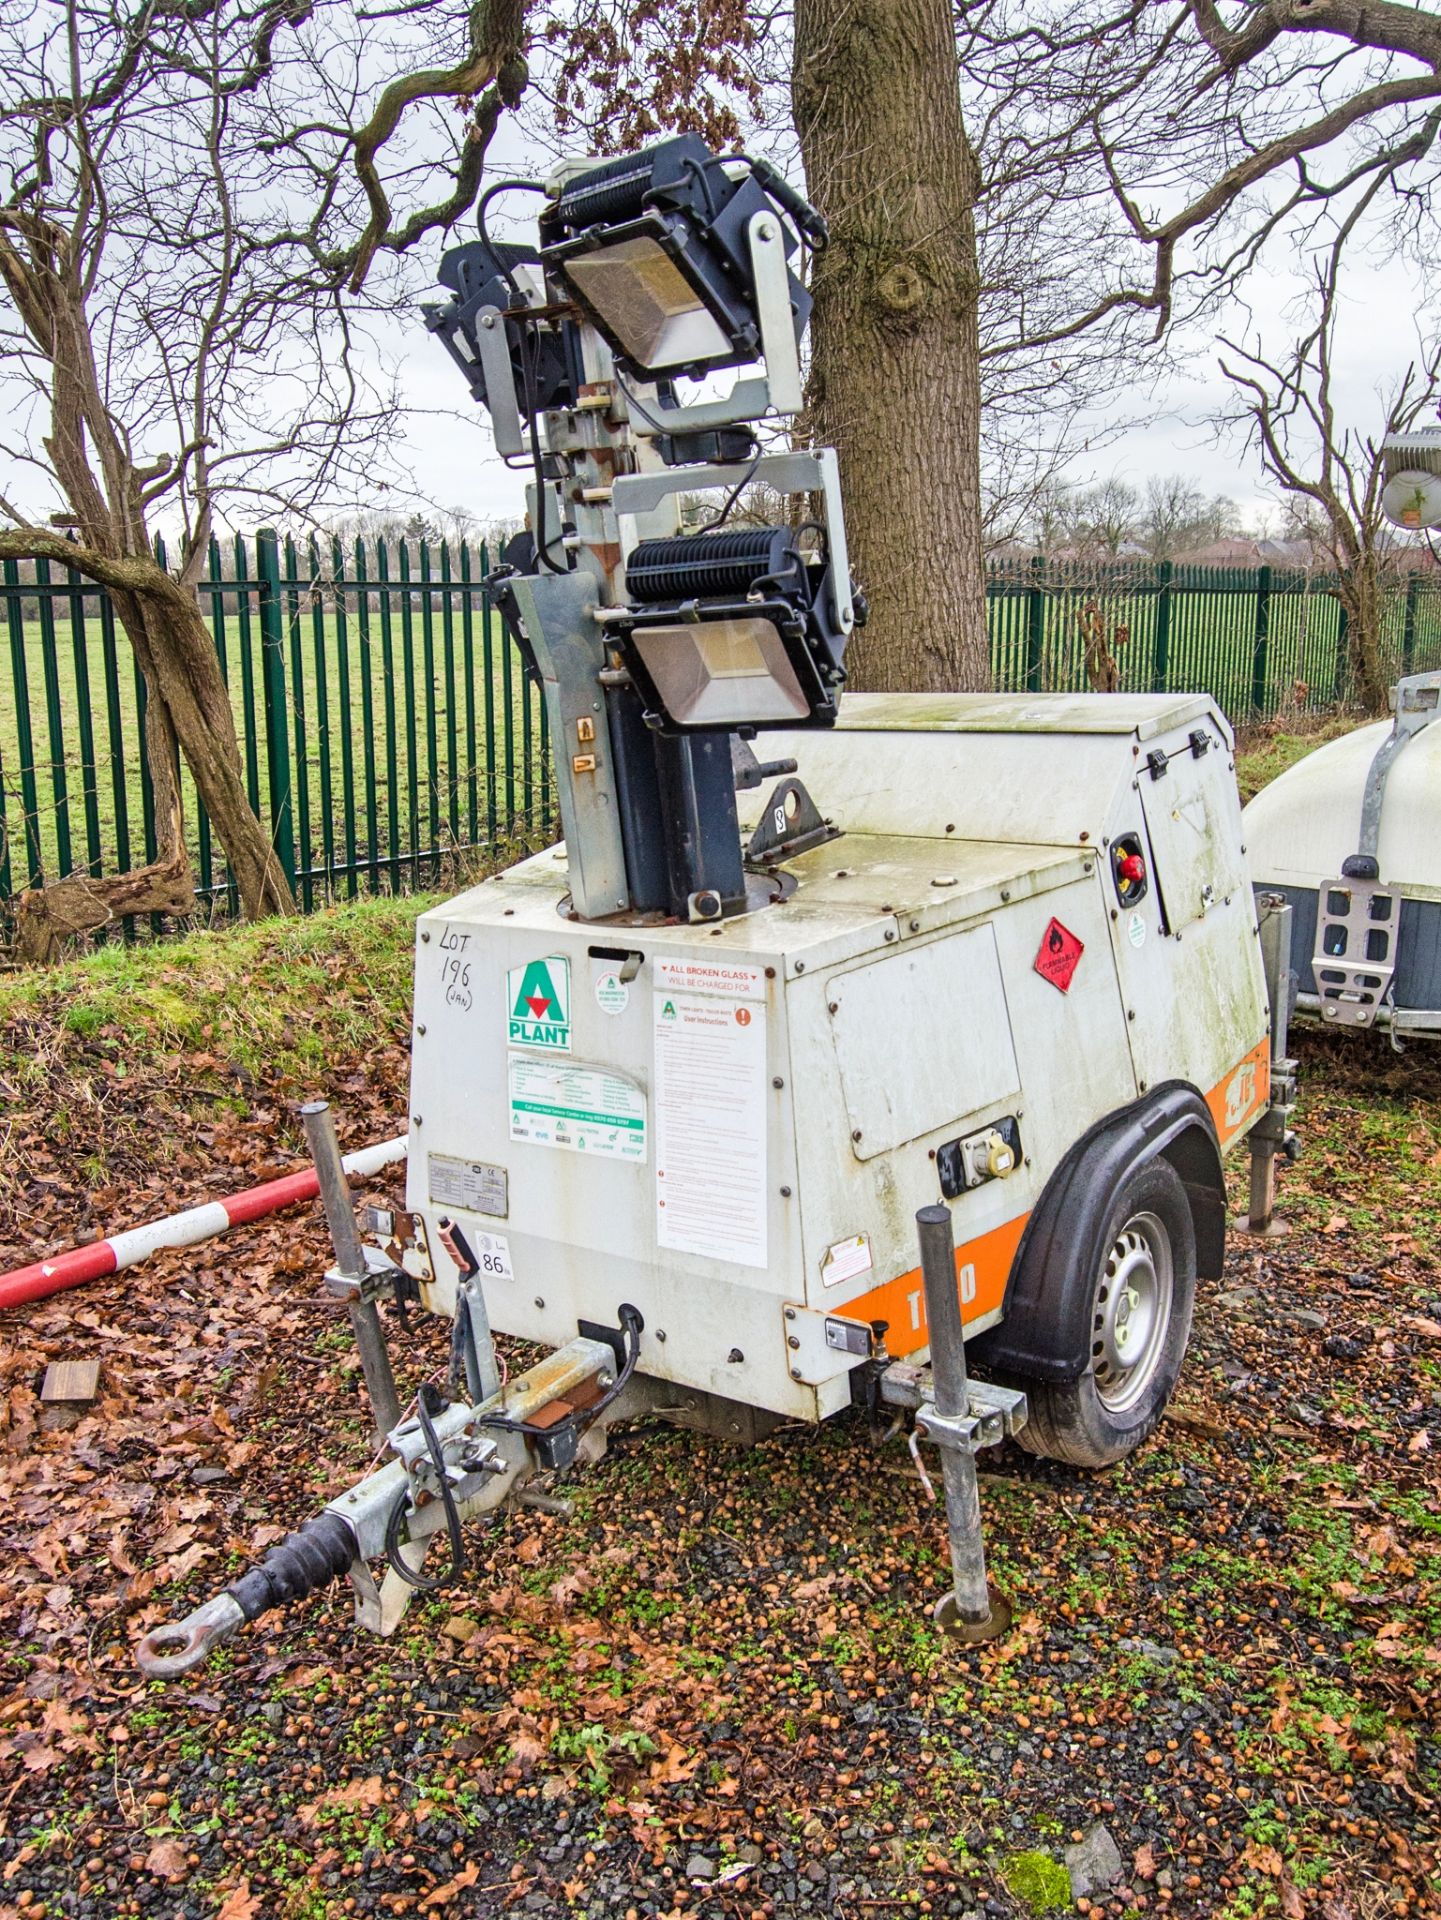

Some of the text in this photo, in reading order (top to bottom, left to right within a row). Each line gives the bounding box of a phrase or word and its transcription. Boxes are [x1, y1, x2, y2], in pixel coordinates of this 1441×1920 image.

[439, 925, 471, 953] LOT
[441, 956, 472, 987] 196
[670, 965, 749, 980] ALL BROKEN GLASS
[513, 960, 565, 1022] A
[668, 976, 751, 993] WILL BE CHARGED FOR
[445, 985, 473, 1012] (JAN)
[509, 1021, 570, 1045] PLANT
[683, 1015, 729, 1027] User Instructions
[482, 1252, 504, 1274] 86
